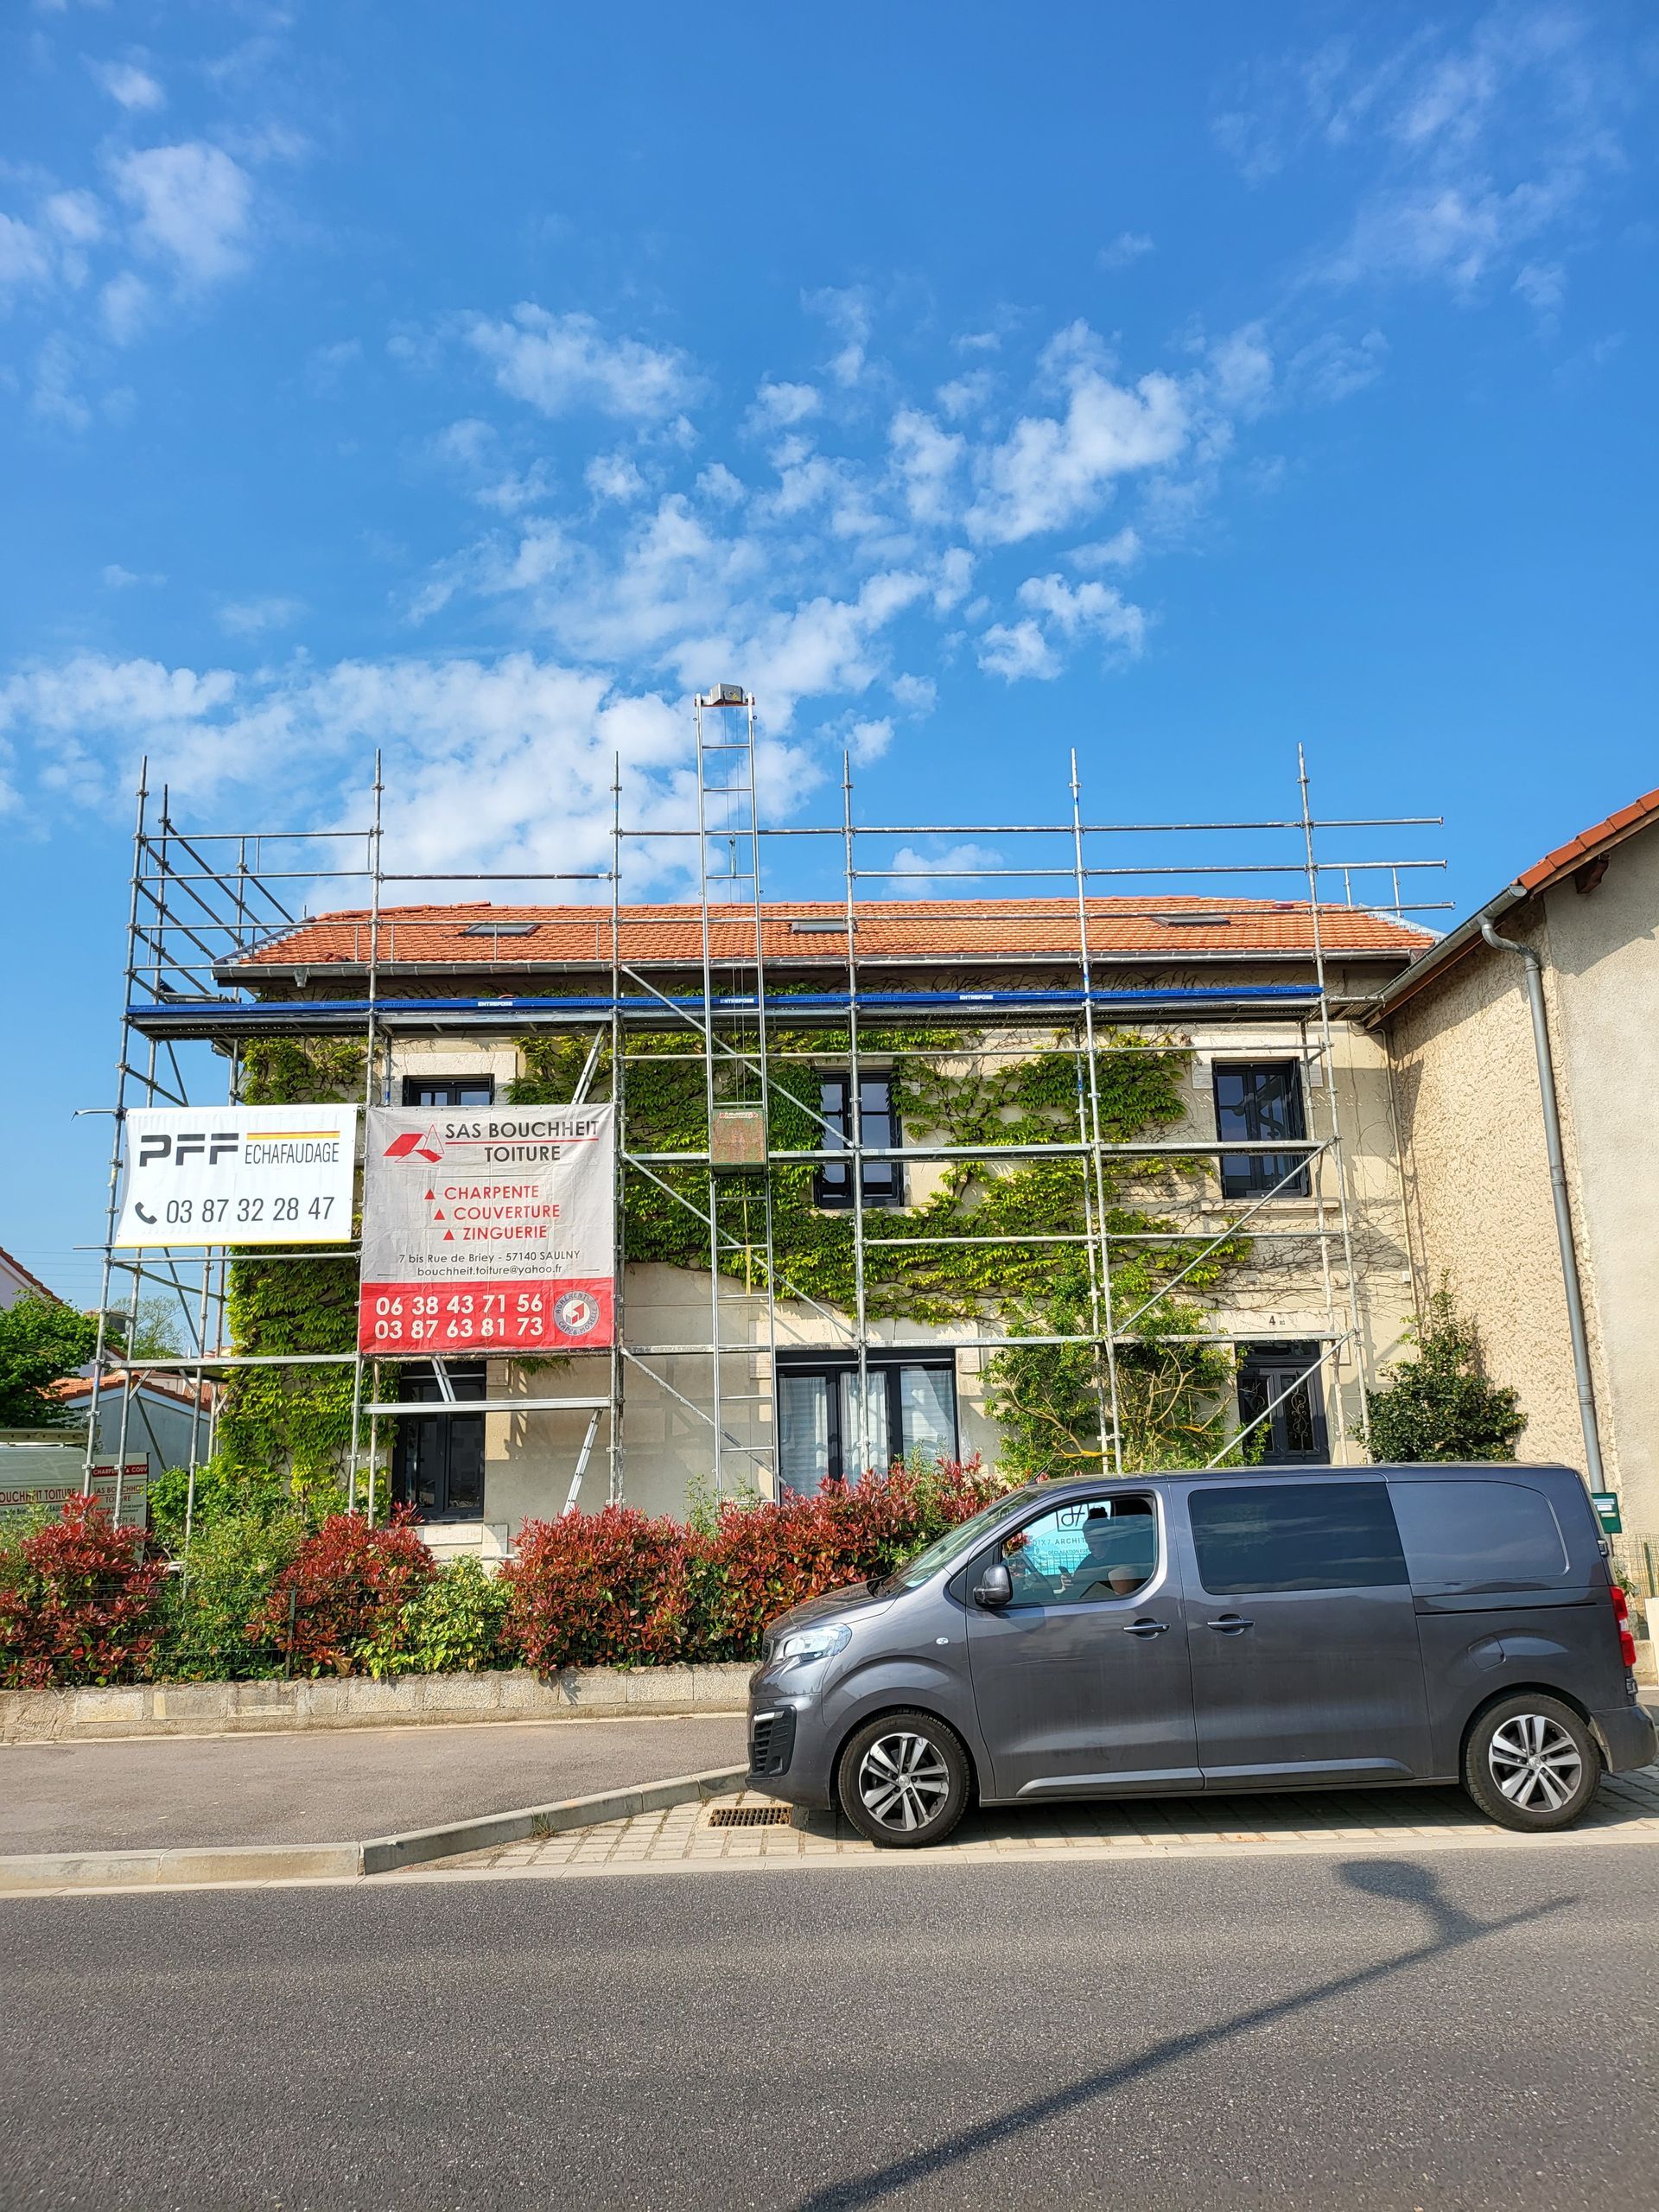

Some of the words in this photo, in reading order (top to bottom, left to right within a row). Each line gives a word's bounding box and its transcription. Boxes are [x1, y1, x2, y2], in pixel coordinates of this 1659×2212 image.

[445, 1123, 481, 1139] SAS
[489, 1121, 599, 1138] BOUCHHEIT
[139, 1133, 239, 1166] PFF
[245, 1143, 340, 1165] ECHAFAUDAGE
[485, 1146, 561, 1162] TOITURE
[444, 1185, 539, 1200] CHARPENTE
[167, 1199, 193, 1224] 03
[202, 1198, 229, 1223] 87
[237, 1198, 264, 1222] 32
[273, 1198, 299, 1221] 28
[308, 1197, 334, 1220] 47
[454, 1205, 560, 1220] COUVERTURE
[463, 1225, 547, 1240] ZINGUERIE
[399, 1255, 405, 1263] 7
[409, 1254, 424, 1263] bis
[428, 1254, 448, 1263] Rue
[451, 1254, 465, 1262] de
[469, 1253, 494, 1264] Briey
[505, 1251, 537, 1262] 57140
[539, 1250, 580, 1261] SAULNY
[417, 1263, 562, 1276] bouchheit.toiture@yahoo.fr
[376, 1297, 404, 1316] 06
[411, 1296, 439, 1315] 38
[446, 1295, 474, 1314] 43
[483, 1294, 505, 1313] 71
[517, 1293, 543, 1313] 56
[374, 1319, 403, 1339] 03
[410, 1319, 439, 1339] 87
[446, 1319, 474, 1338] 63
[480, 1318, 505, 1337] 81
[518, 1317, 543, 1336] 73
